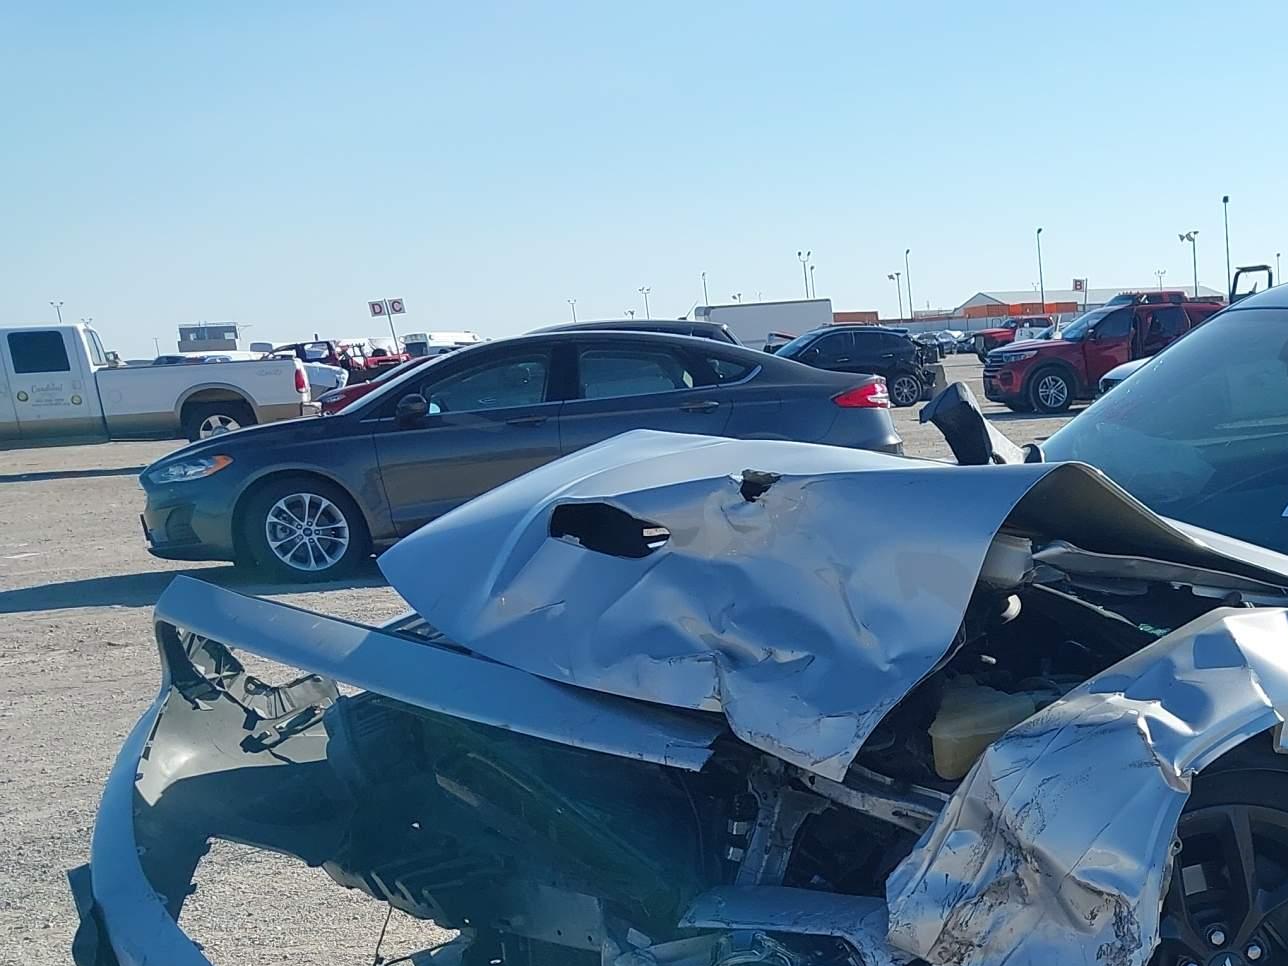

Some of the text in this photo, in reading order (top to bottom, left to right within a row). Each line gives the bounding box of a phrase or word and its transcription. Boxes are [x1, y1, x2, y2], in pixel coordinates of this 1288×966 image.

[1075, 280, 1083, 291] B
[371, 303, 383, 315] D
[391, 300, 403, 313] C
